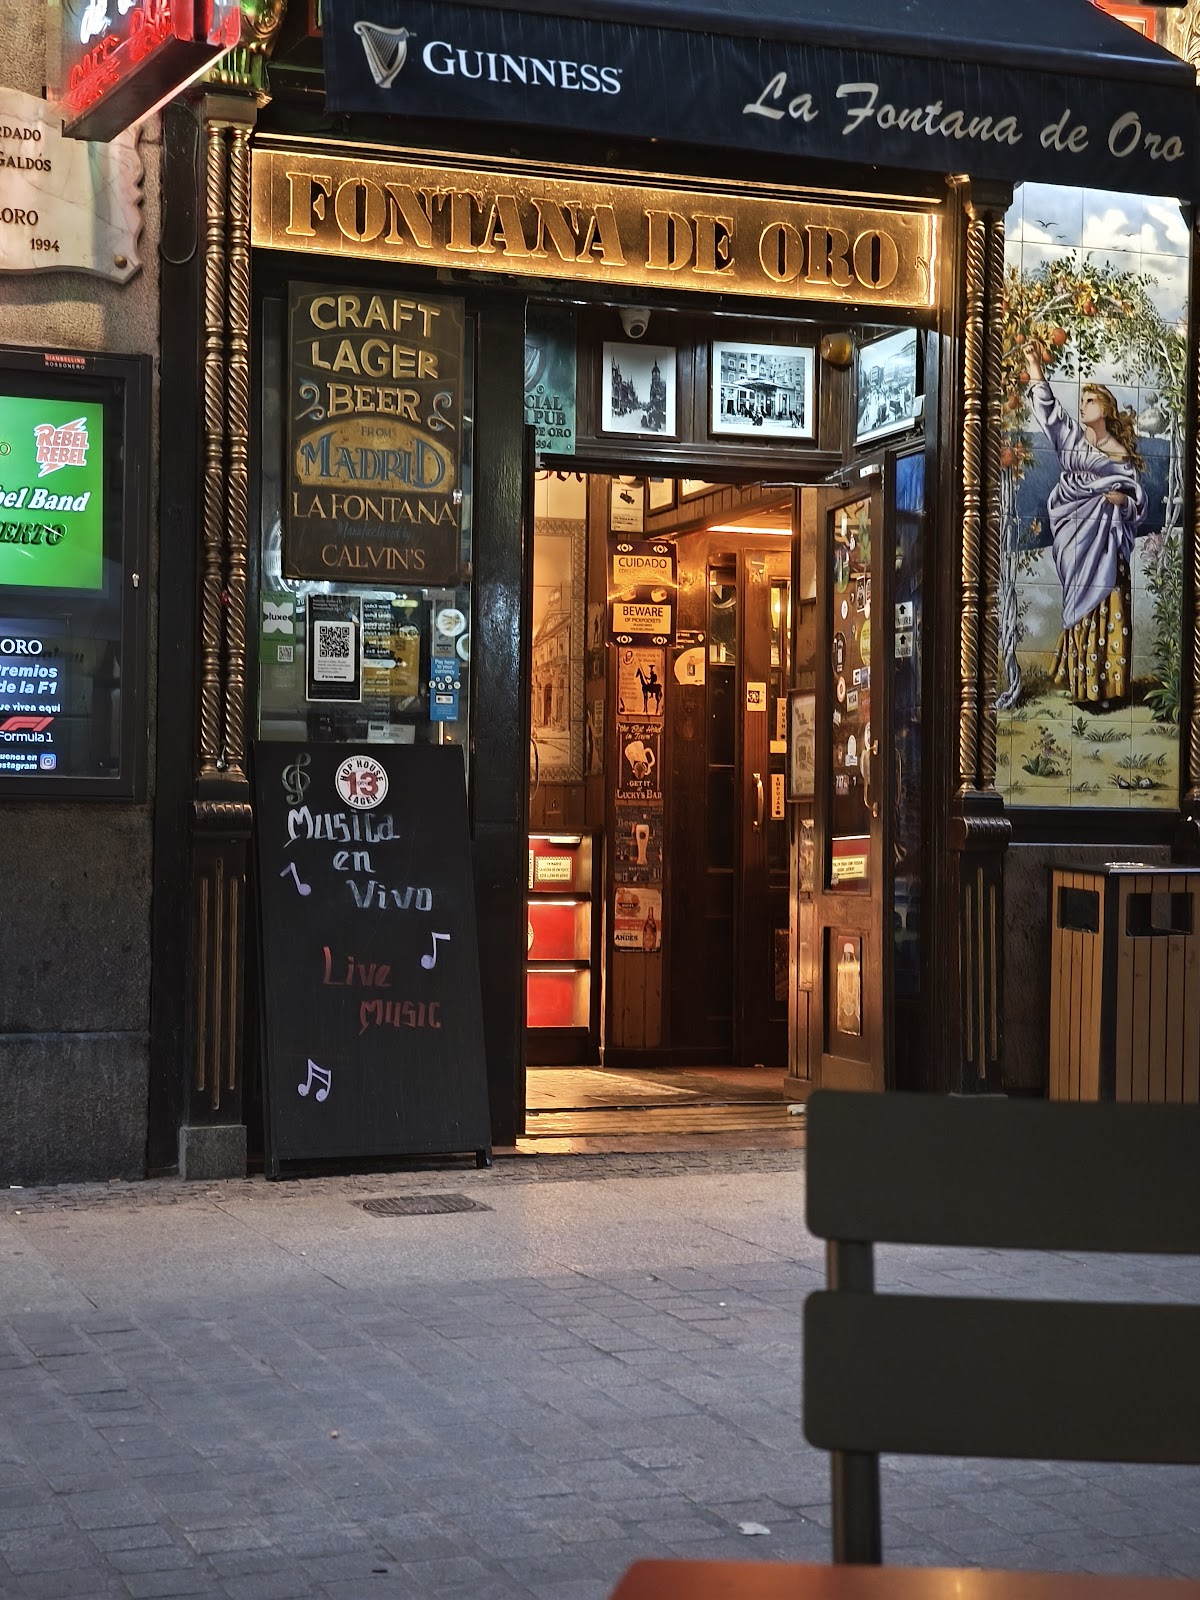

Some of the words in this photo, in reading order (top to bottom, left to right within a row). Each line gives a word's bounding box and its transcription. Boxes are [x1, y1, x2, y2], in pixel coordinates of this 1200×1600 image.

[423, 41, 621, 94] GUINNESS
[743, 71, 818, 122] La
[836, 82, 1022, 145] Fontana
[1039, 109, 1089, 152] de
[1107, 112, 1185, 161] Oro
[0, 126, 41, 141] DADO
[2, 207, 38, 225] ORO
[286, 172, 627, 266] FONTANA
[645, 209, 735, 276] DE
[759, 222, 898, 289] ORO
[30, 238, 60, 252] 1994
[309, 295, 440, 338] CRAFT
[311, 338, 439, 379] LAGER
[326, 382, 422, 423] BEER
[533, 411, 566, 426] PUB
[35, 425, 88, 449] REBEL
[360, 425, 392, 438] FROM
[548, 427, 571, 438] ORO
[536, 439, 552, 449] 994
[37, 447, 86, 465] REBEL
[300, 430, 446, 489] MADRID
[28, 488, 91, 511] Band
[292, 491, 326, 518] LA
[331, 495, 457, 527] FONTANA
[322, 544, 425, 570] CALVIN'S
[618, 557, 667, 568] CUIDADO
[623, 606, 663, 617] BEWARE
[1, 639, 43, 655] ORO
[0, 664, 58, 678] remios
[19, 681, 35, 694] la
[38, 681, 57, 694] F1
[12, 701, 37, 711] viven
[0, 762, 37, 771] stagram
[340, 763, 353, 781] HOP
[356, 760, 384, 782] HOUSE
[347, 771, 379, 796] 13
[348, 794, 378, 805] LAGER
[333, 851, 376, 873] en
[346, 879, 433, 911] Vivo
[322, 946, 391, 987] Live
